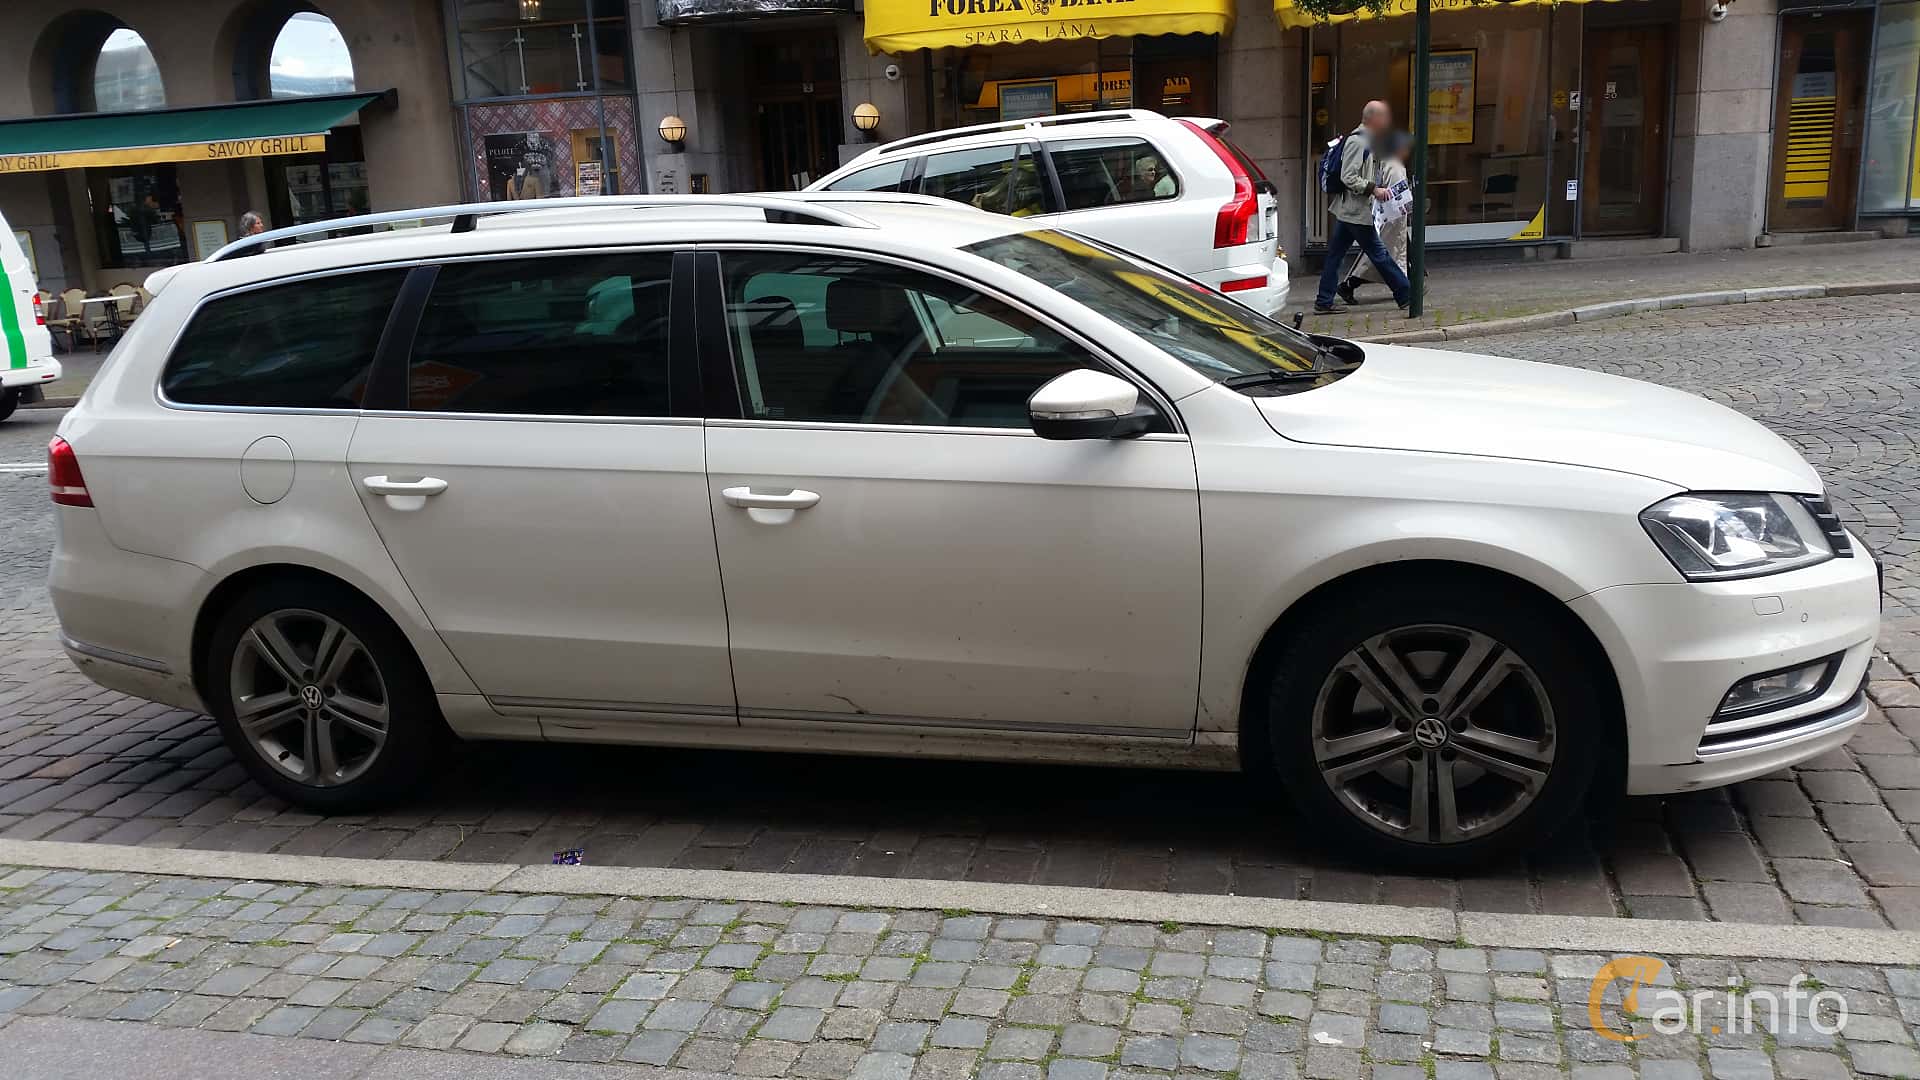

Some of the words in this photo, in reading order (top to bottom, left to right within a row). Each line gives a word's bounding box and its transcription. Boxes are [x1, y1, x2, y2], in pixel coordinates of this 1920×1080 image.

[964, 28, 1023, 43] SPARA
[1045, 22, 1097, 37] LÅNA
[208, 139, 256, 158] SAVOY
[261, 136, 308, 153] GRILL
[18, 153, 59, 170] GRILL
